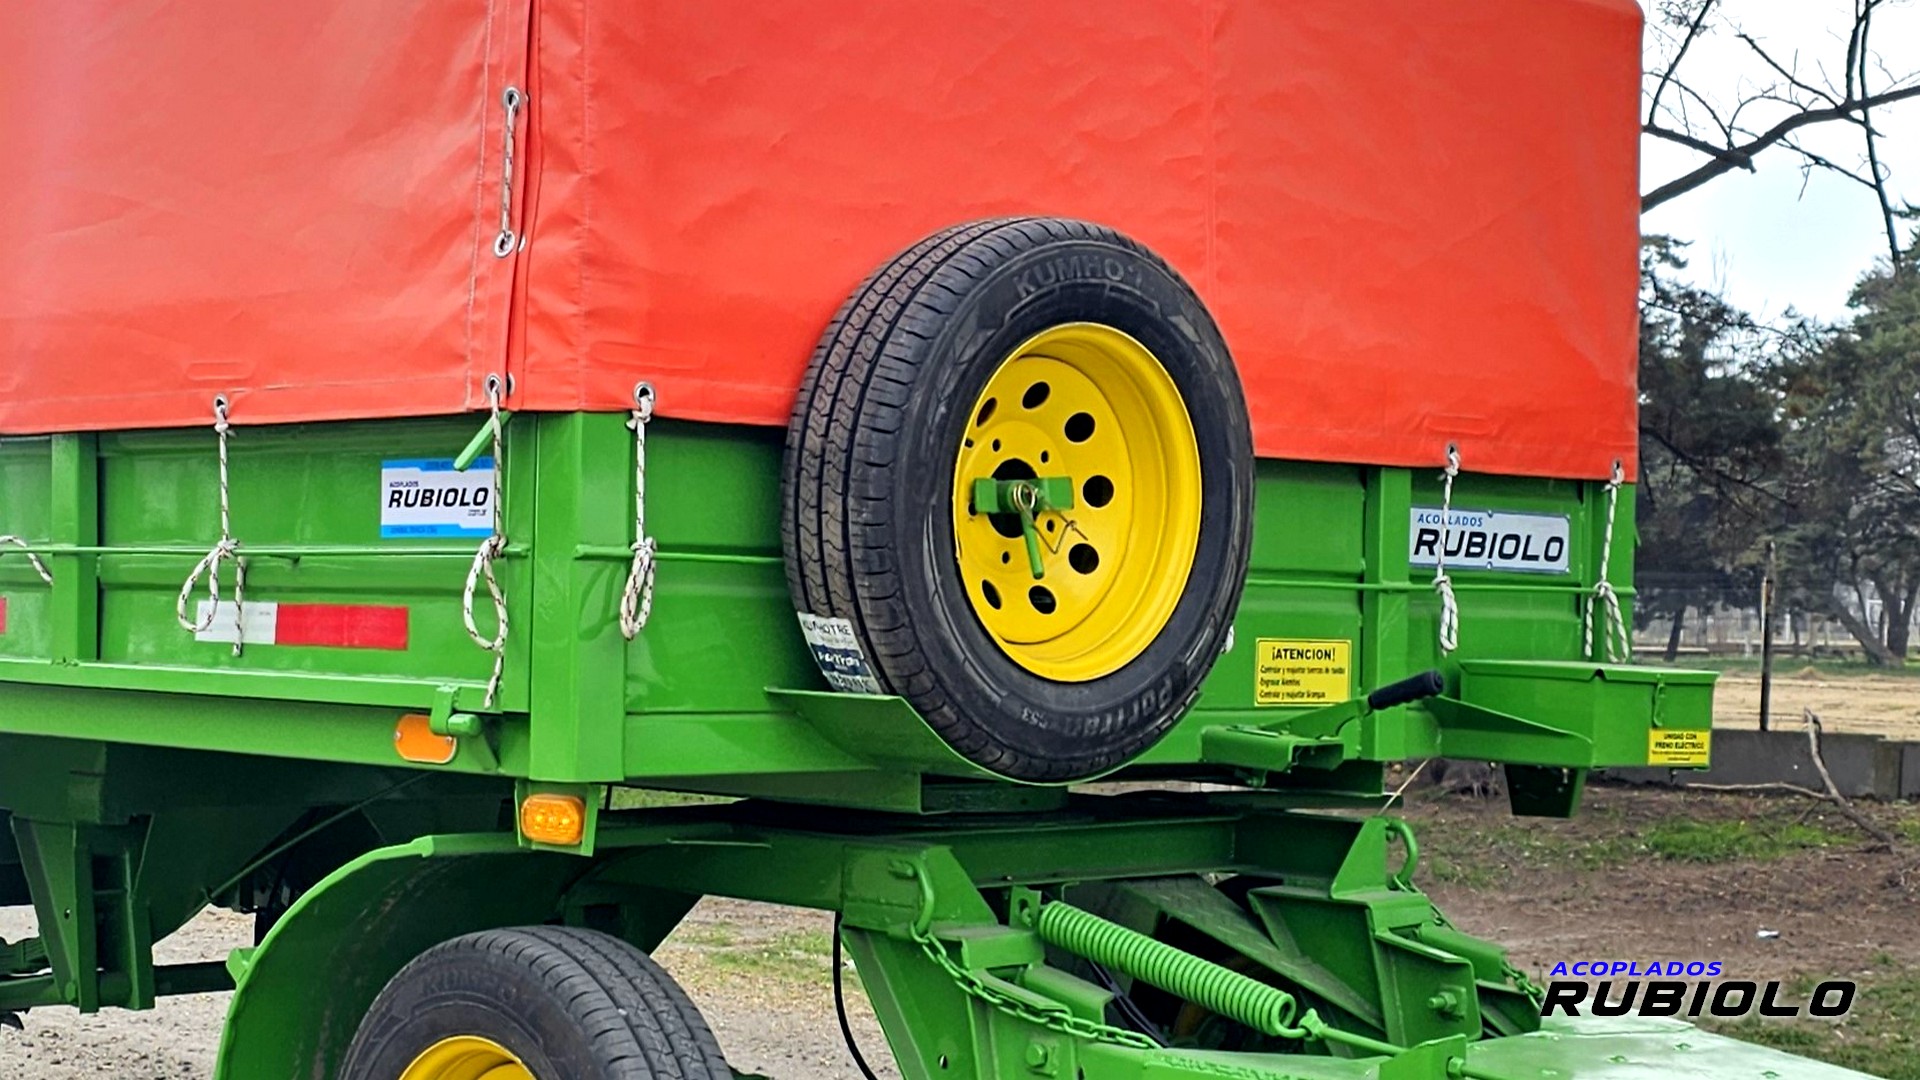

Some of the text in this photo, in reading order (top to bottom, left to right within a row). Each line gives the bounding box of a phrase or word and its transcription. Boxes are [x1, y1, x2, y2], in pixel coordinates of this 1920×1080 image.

[1012, 254, 1124, 298] KUMHO
[388, 487, 489, 508] RUBIOLO
[1413, 528, 1564, 562] RUBIOLO
[1271, 647, 1336, 661] ¡ATENCION!
